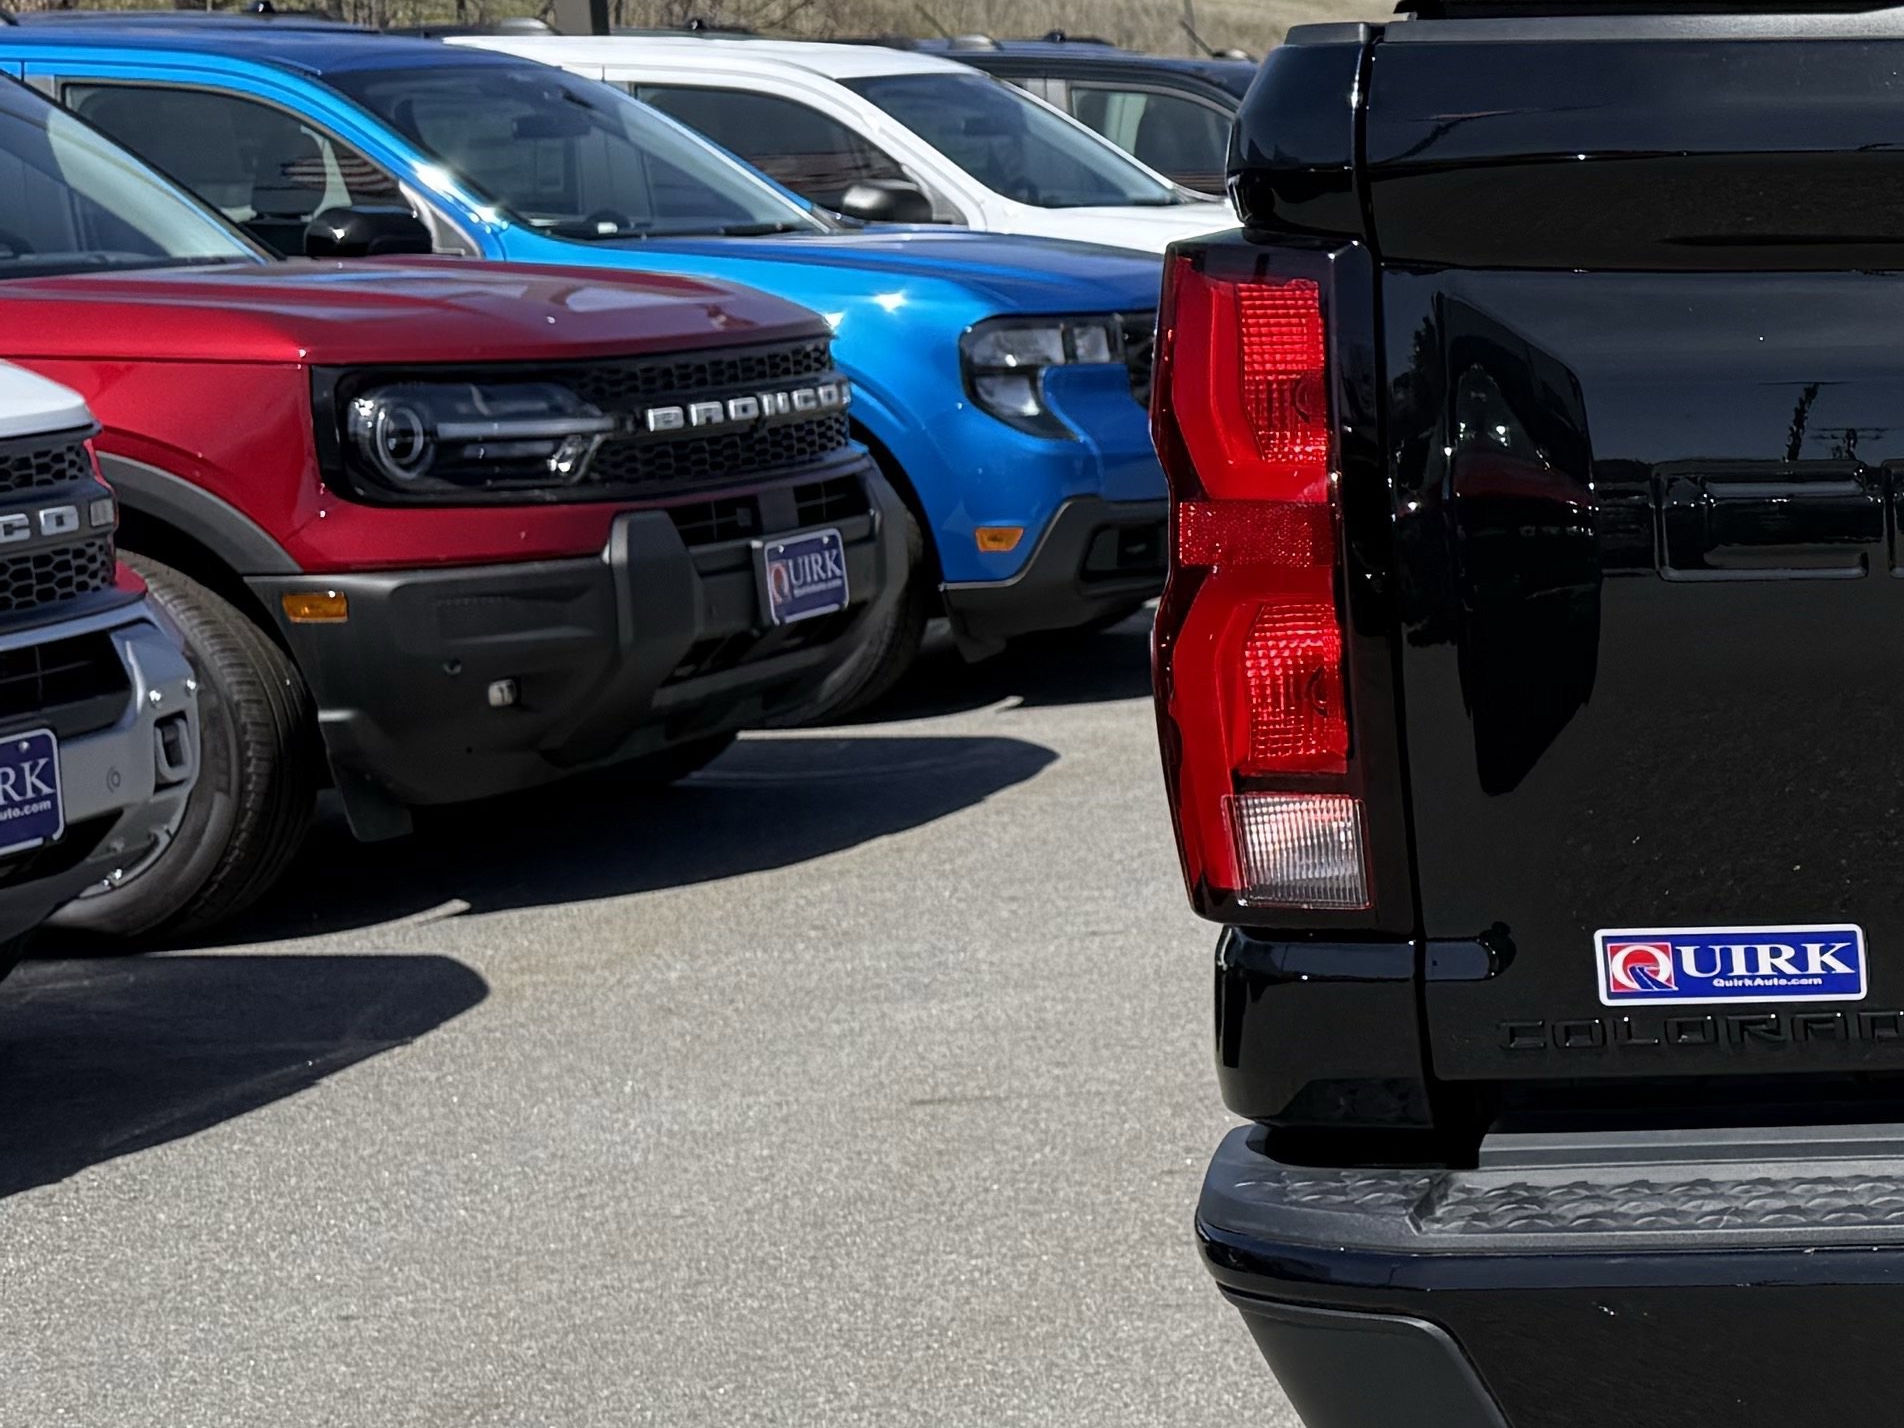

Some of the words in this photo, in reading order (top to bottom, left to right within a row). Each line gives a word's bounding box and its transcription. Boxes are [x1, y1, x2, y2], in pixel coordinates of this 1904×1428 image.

[646, 383, 838, 432] BRONCO
[769, 548, 844, 604] QUIRK
[1610, 941, 1857, 991] QUIRK
[1712, 976, 1823, 989] QuirkAuto.com
